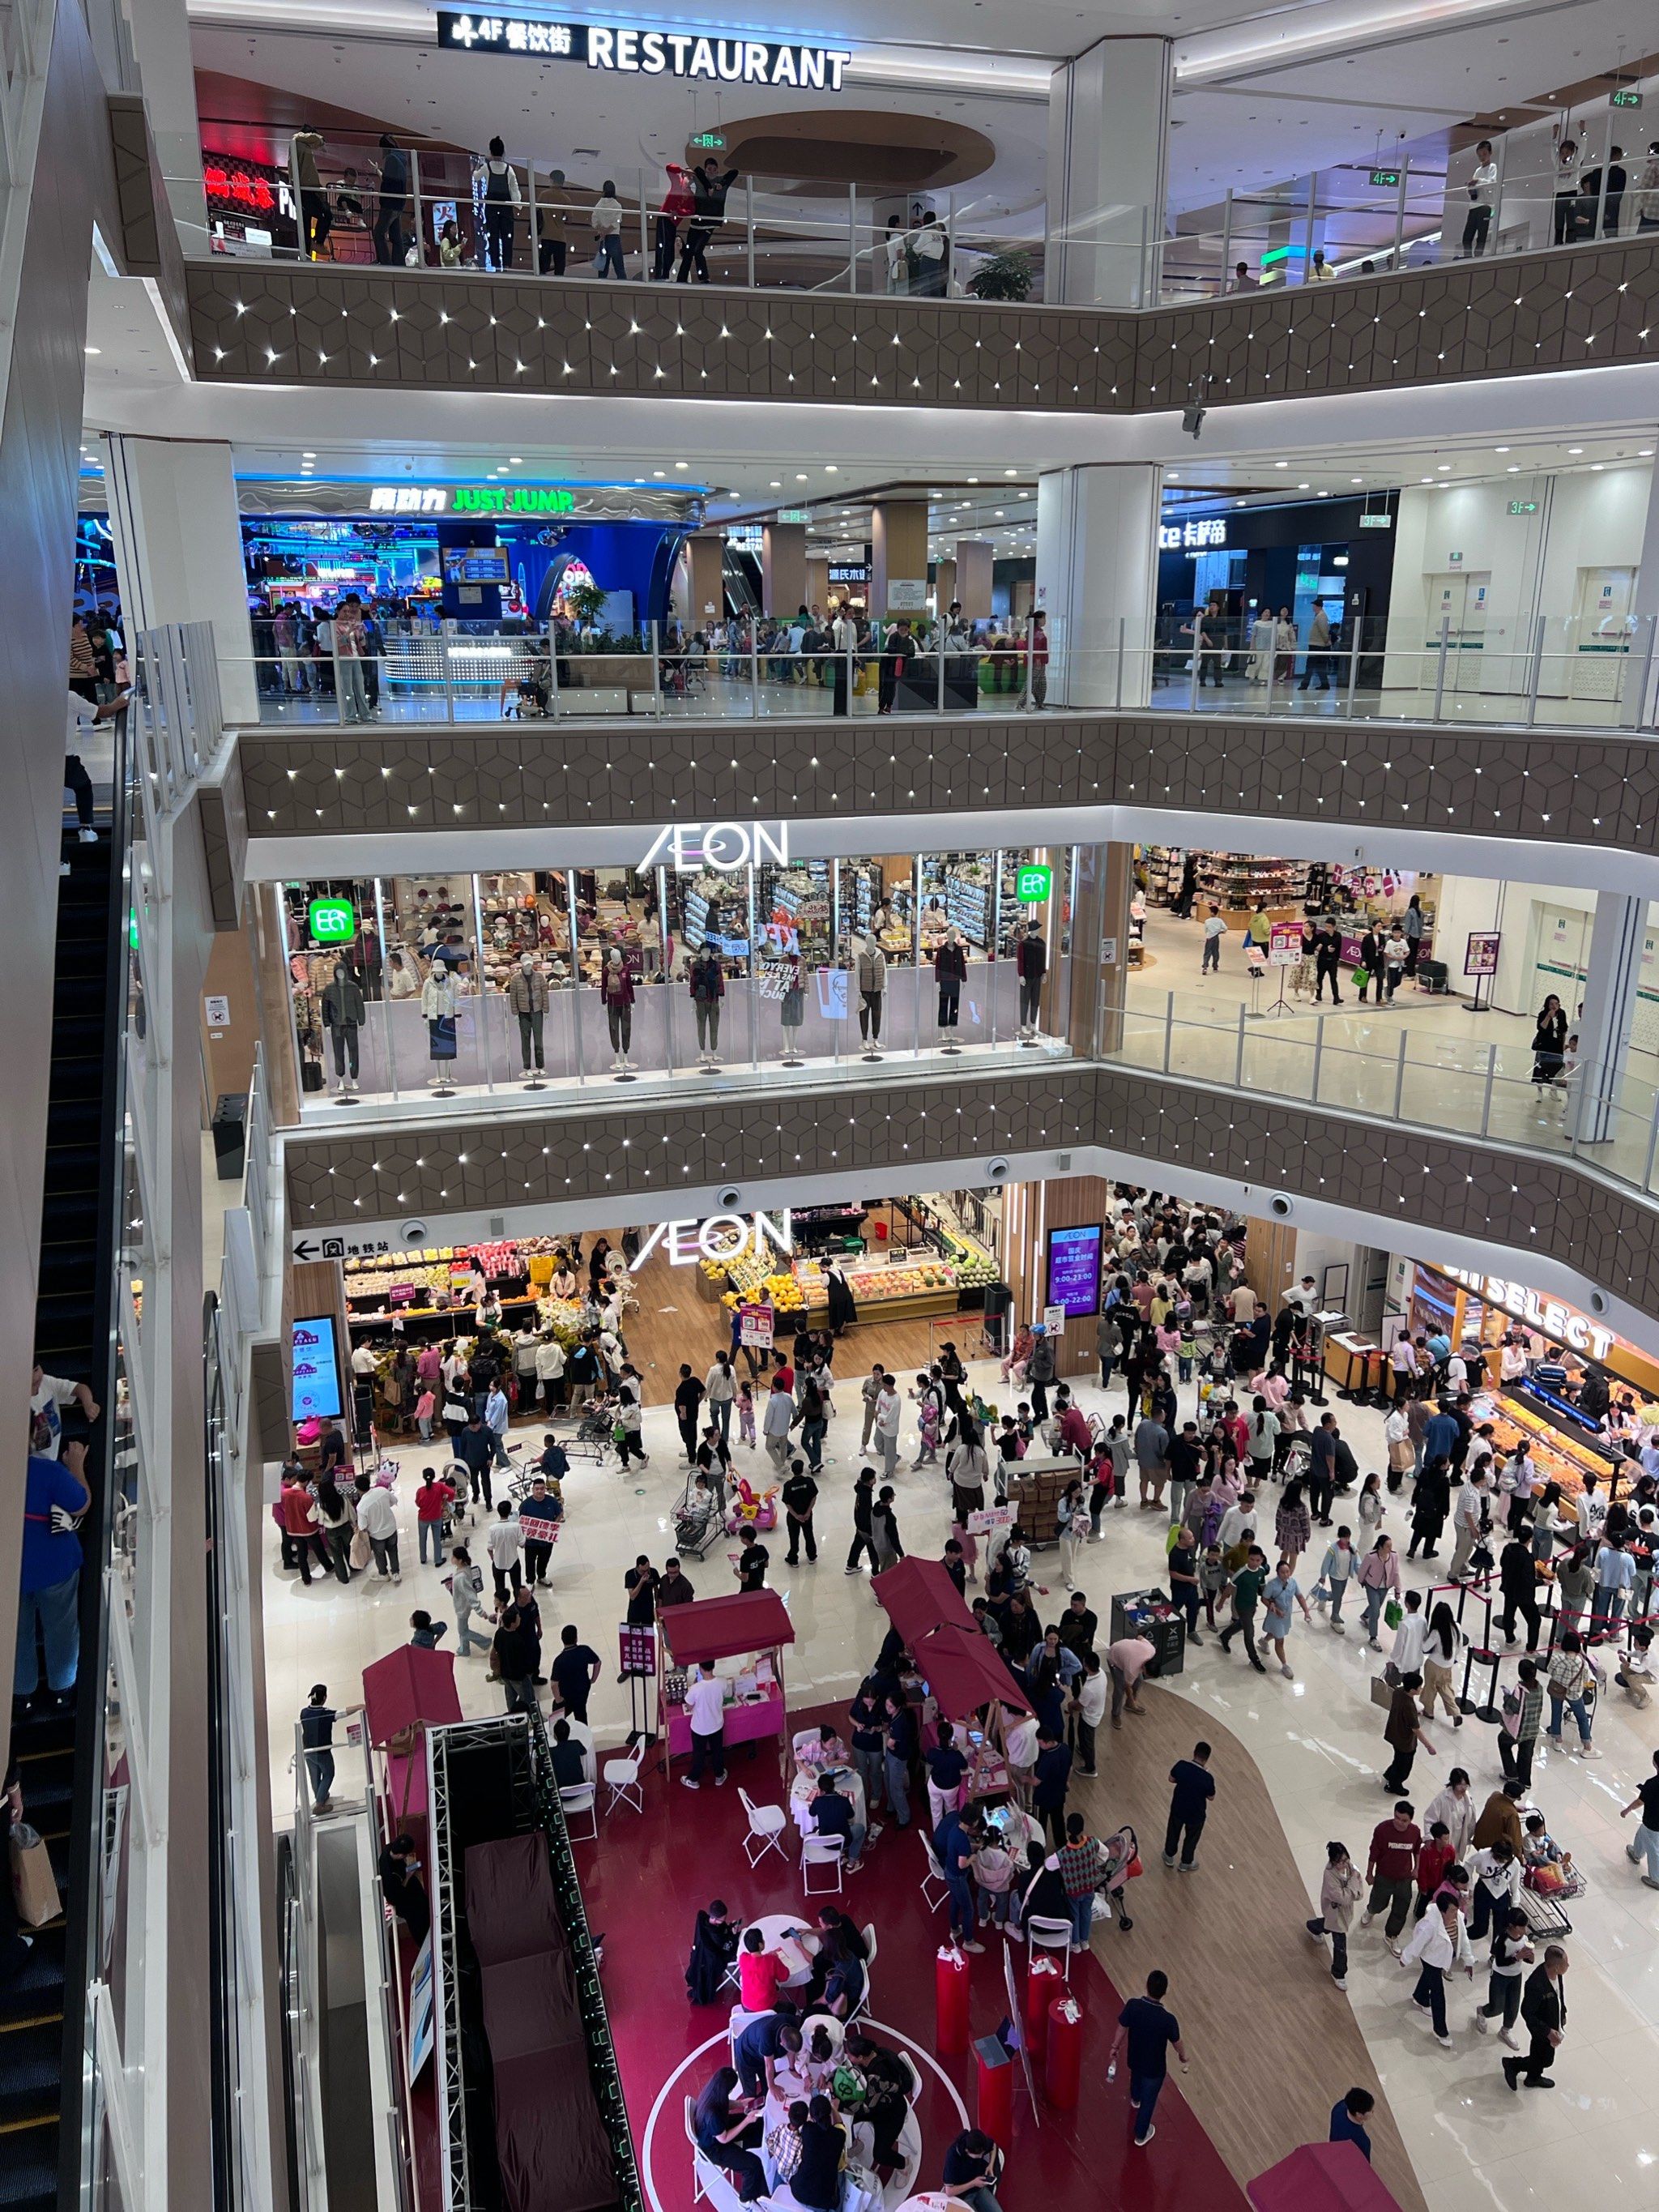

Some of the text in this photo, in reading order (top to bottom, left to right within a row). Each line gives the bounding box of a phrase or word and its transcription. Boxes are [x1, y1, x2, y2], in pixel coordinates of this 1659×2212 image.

[478, 19, 503, 41] 4F
[588, 27, 851, 90] RESTAURANT
[1614, 92, 1628, 105] 4F
[1373, 173, 1386, 185] 4F
[452, 489, 506, 511] JUST
[1512, 502, 1525, 514] 3F
[1363, 516, 1376, 527] 3F
[348, 1241, 389, 1255] 地铁站
[1055, 1273, 1092, 1283] 9:00-23:00
[1487, 1277, 1615, 1360] SELECT
